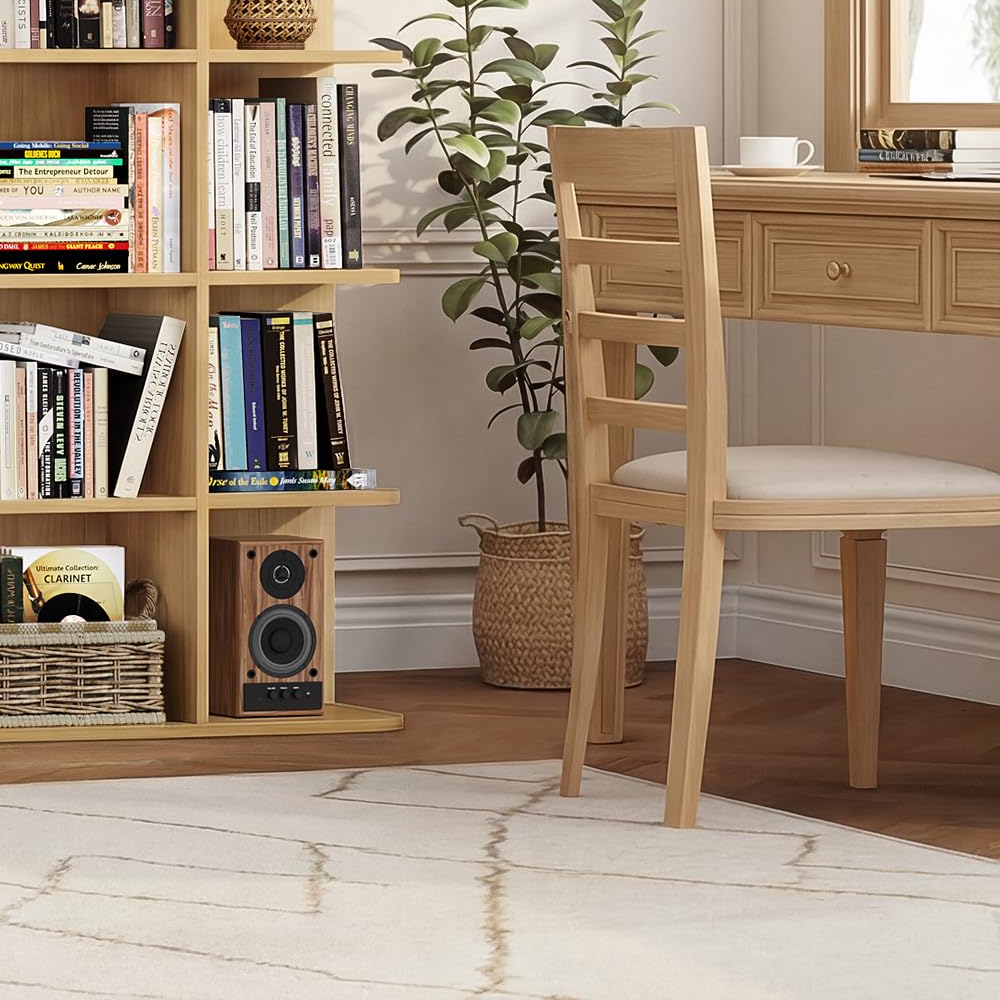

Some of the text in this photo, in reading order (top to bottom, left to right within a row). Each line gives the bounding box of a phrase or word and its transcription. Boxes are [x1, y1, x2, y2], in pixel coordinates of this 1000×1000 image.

[321, 94, 335, 157] connected
[217, 115, 228, 207] how children learn
[34, 168, 82, 176] Entrepreneur
[23, 186, 44, 195] YOU
[56, 395, 64, 429] STEVEN
[74, 421, 80, 429] IN
[35, 564, 100, 573] Ultimate Collection:
[43, 574, 92, 583] CLARINET
